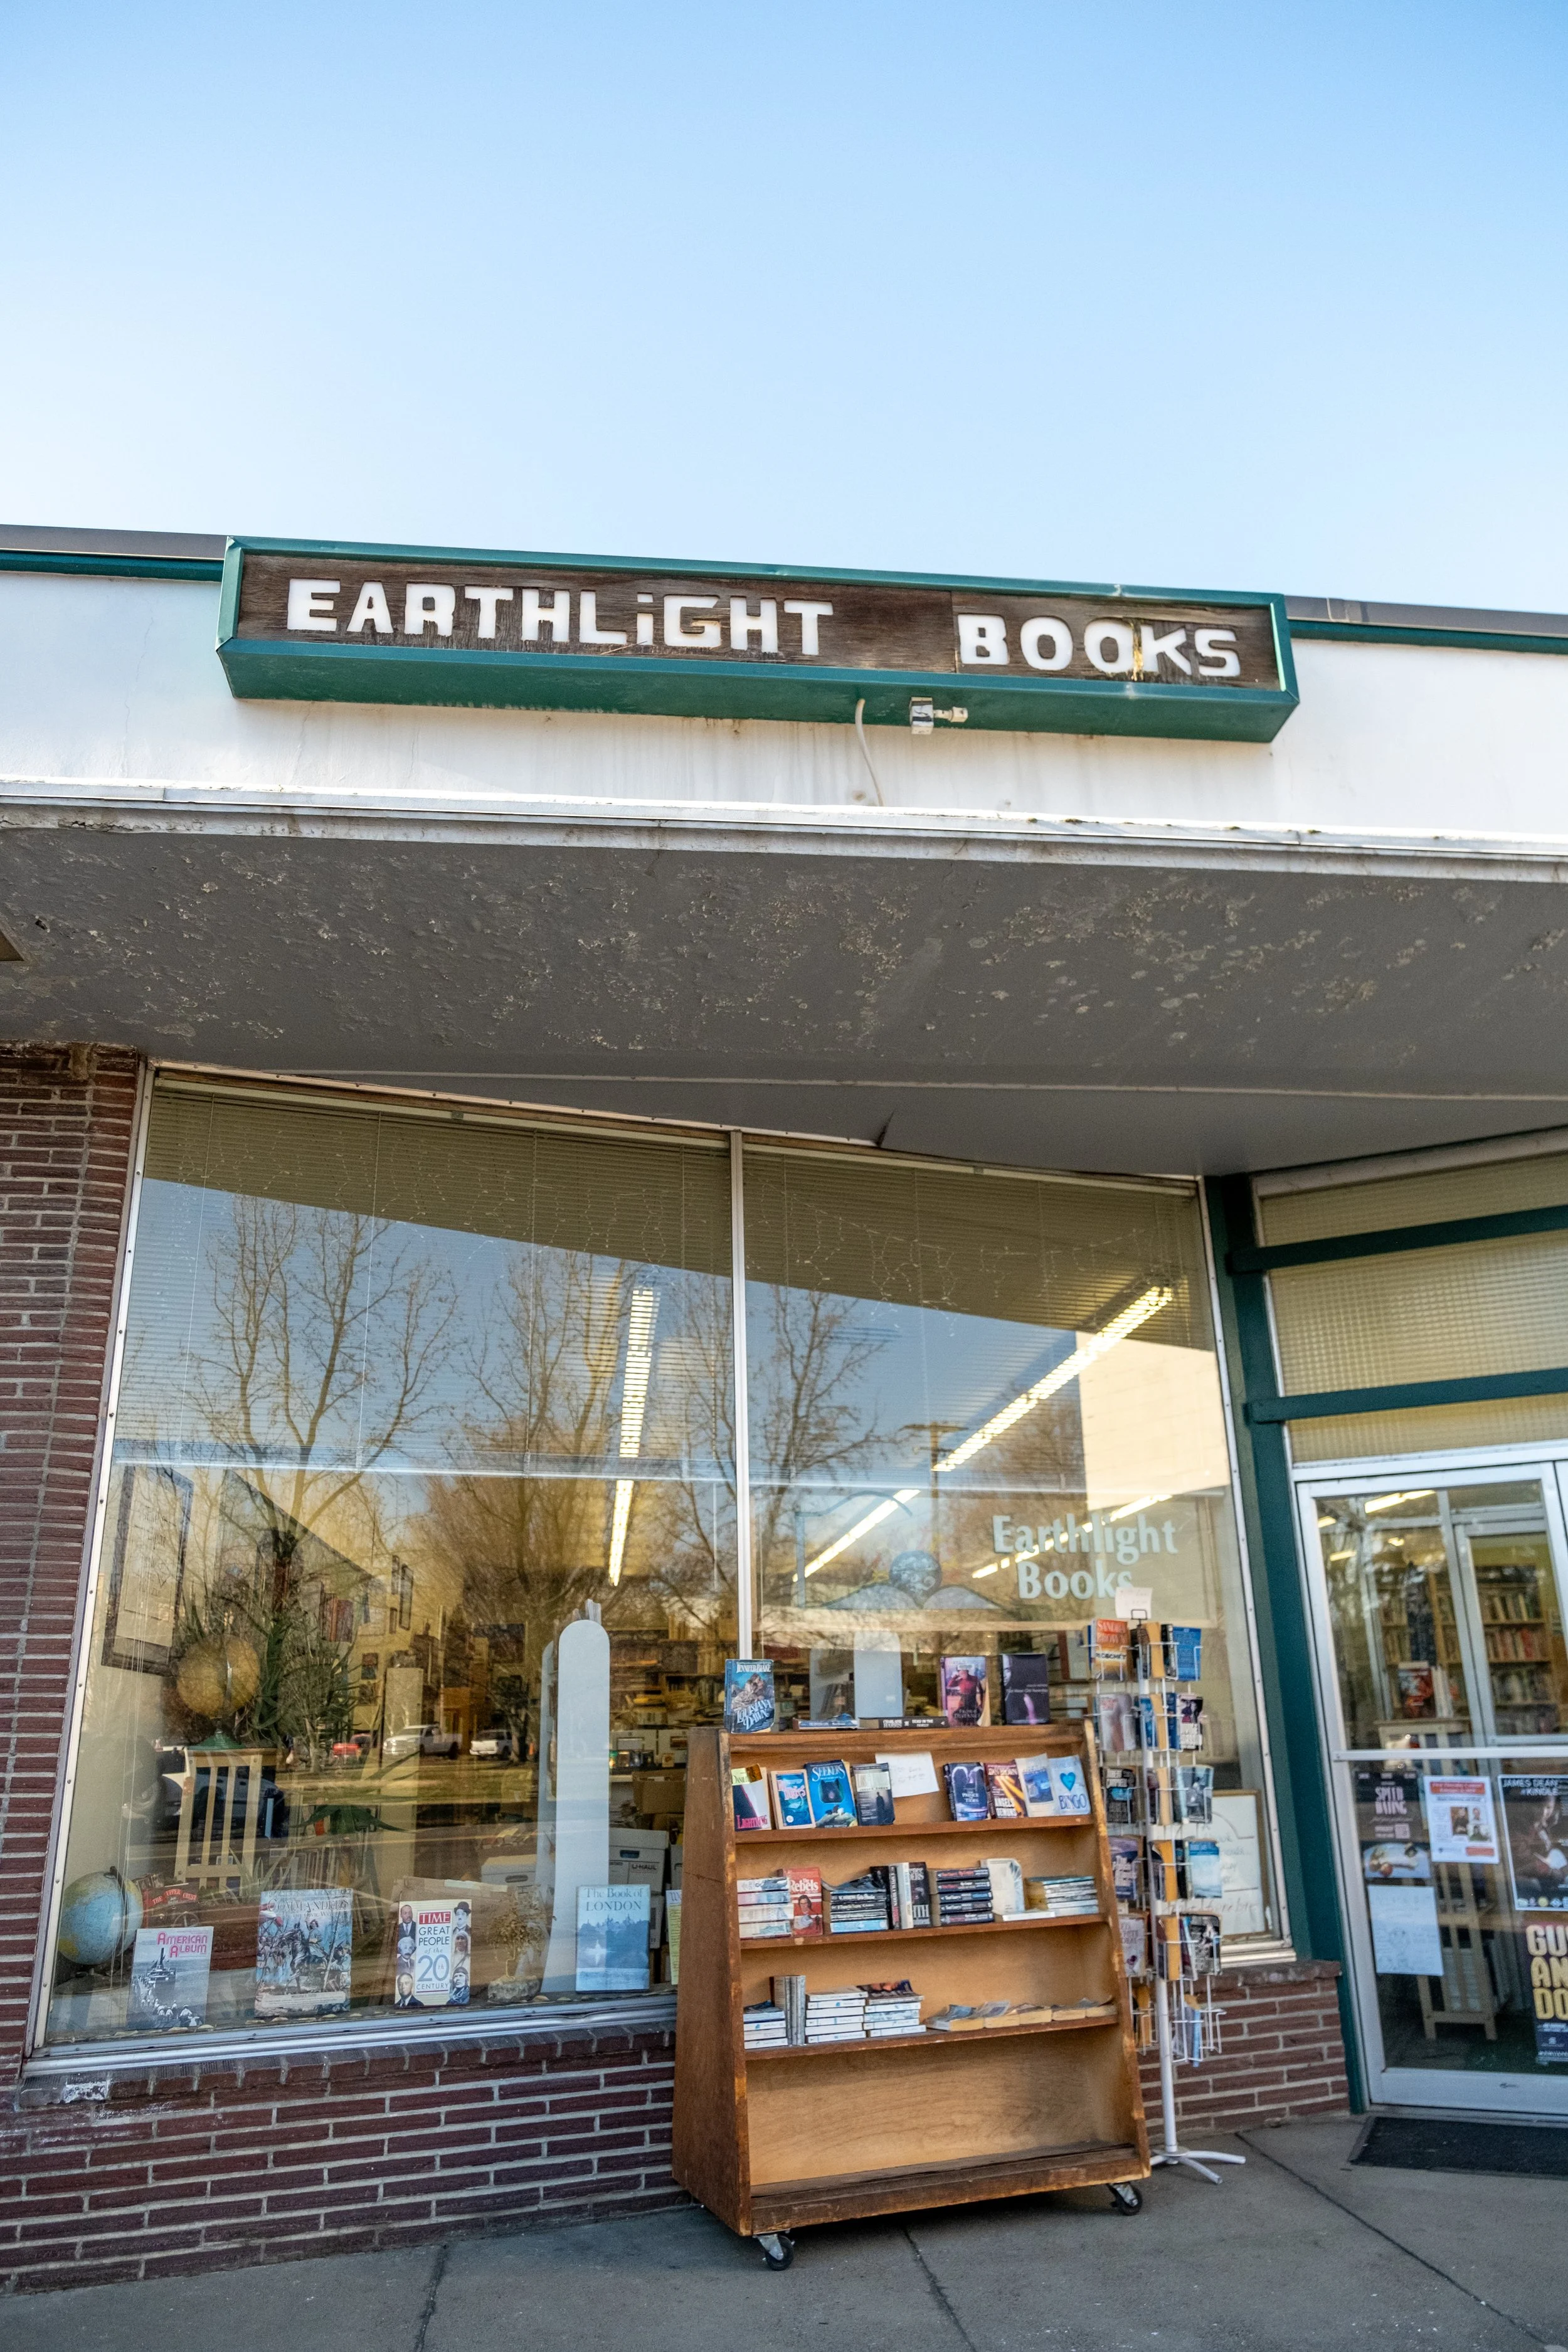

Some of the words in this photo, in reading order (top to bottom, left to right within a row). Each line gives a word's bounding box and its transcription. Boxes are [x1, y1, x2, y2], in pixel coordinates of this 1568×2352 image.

[957, 613, 1242, 679] BOOKS
[992, 1513, 1179, 1565] Earthlight
[1017, 1560, 1133, 1599] Books
[1503, 1779, 1532, 1788] JAMES
[1059, 1793, 1087, 1809] BINGO
[790, 1878, 818, 1892] Rebels
[152, 1895, 162, 1904] THE
[585, 1888, 603, 1898] The
[607, 1888, 632, 1898] Book
[634, 1888, 644, 1897] of
[268, 1899, 349, 1912] COMMANDERS
[586, 1901, 642, 1911] LONDON
[420, 1912, 450, 1924] TIME
[156, 1931, 208, 1945] AMERICAN
[419, 1926, 450, 1936] GREAT
[418, 1937, 450, 1946] PEOPLE
[1526, 1924, 1568, 1957] GU
[169, 1944, 207, 1958] ALBUM
[417, 1954, 450, 1982] 20
[1531, 1956, 1568, 1988] AN
[1534, 1988, 1568, 2020] DO
